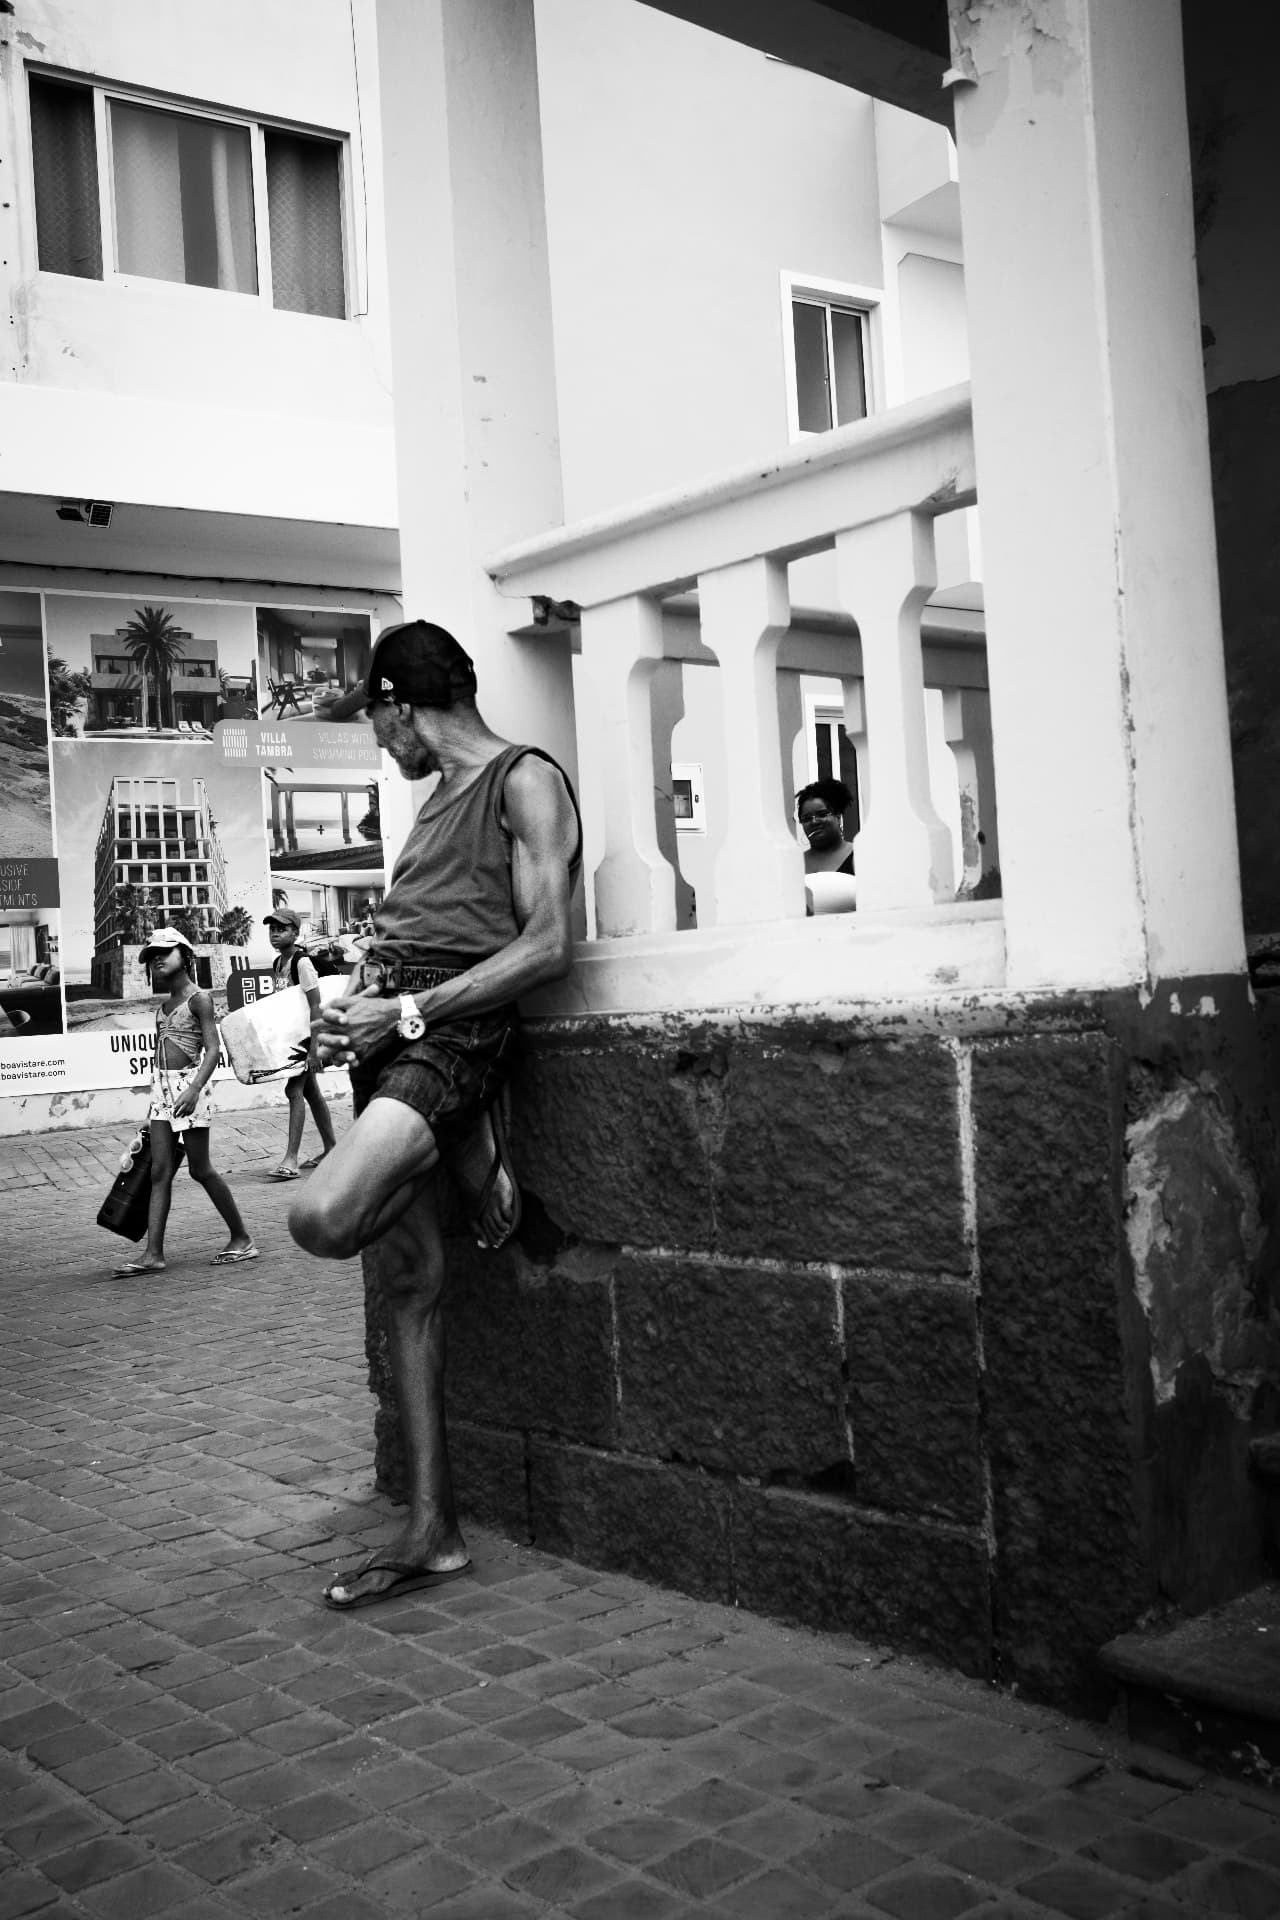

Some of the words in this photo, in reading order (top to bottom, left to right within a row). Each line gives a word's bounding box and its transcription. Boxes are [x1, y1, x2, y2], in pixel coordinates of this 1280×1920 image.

[260, 732, 287, 744] VILLA
[317, 732, 349, 744] VILLAS
[256, 745, 293, 757] TAMBRA
[312, 748, 355, 760] SWIMMING
[0, 878, 23, 892] SIDE
[0, 1059, 65, 1070] boavistare.com
[1, 1070, 66, 1081] boavistare.com
